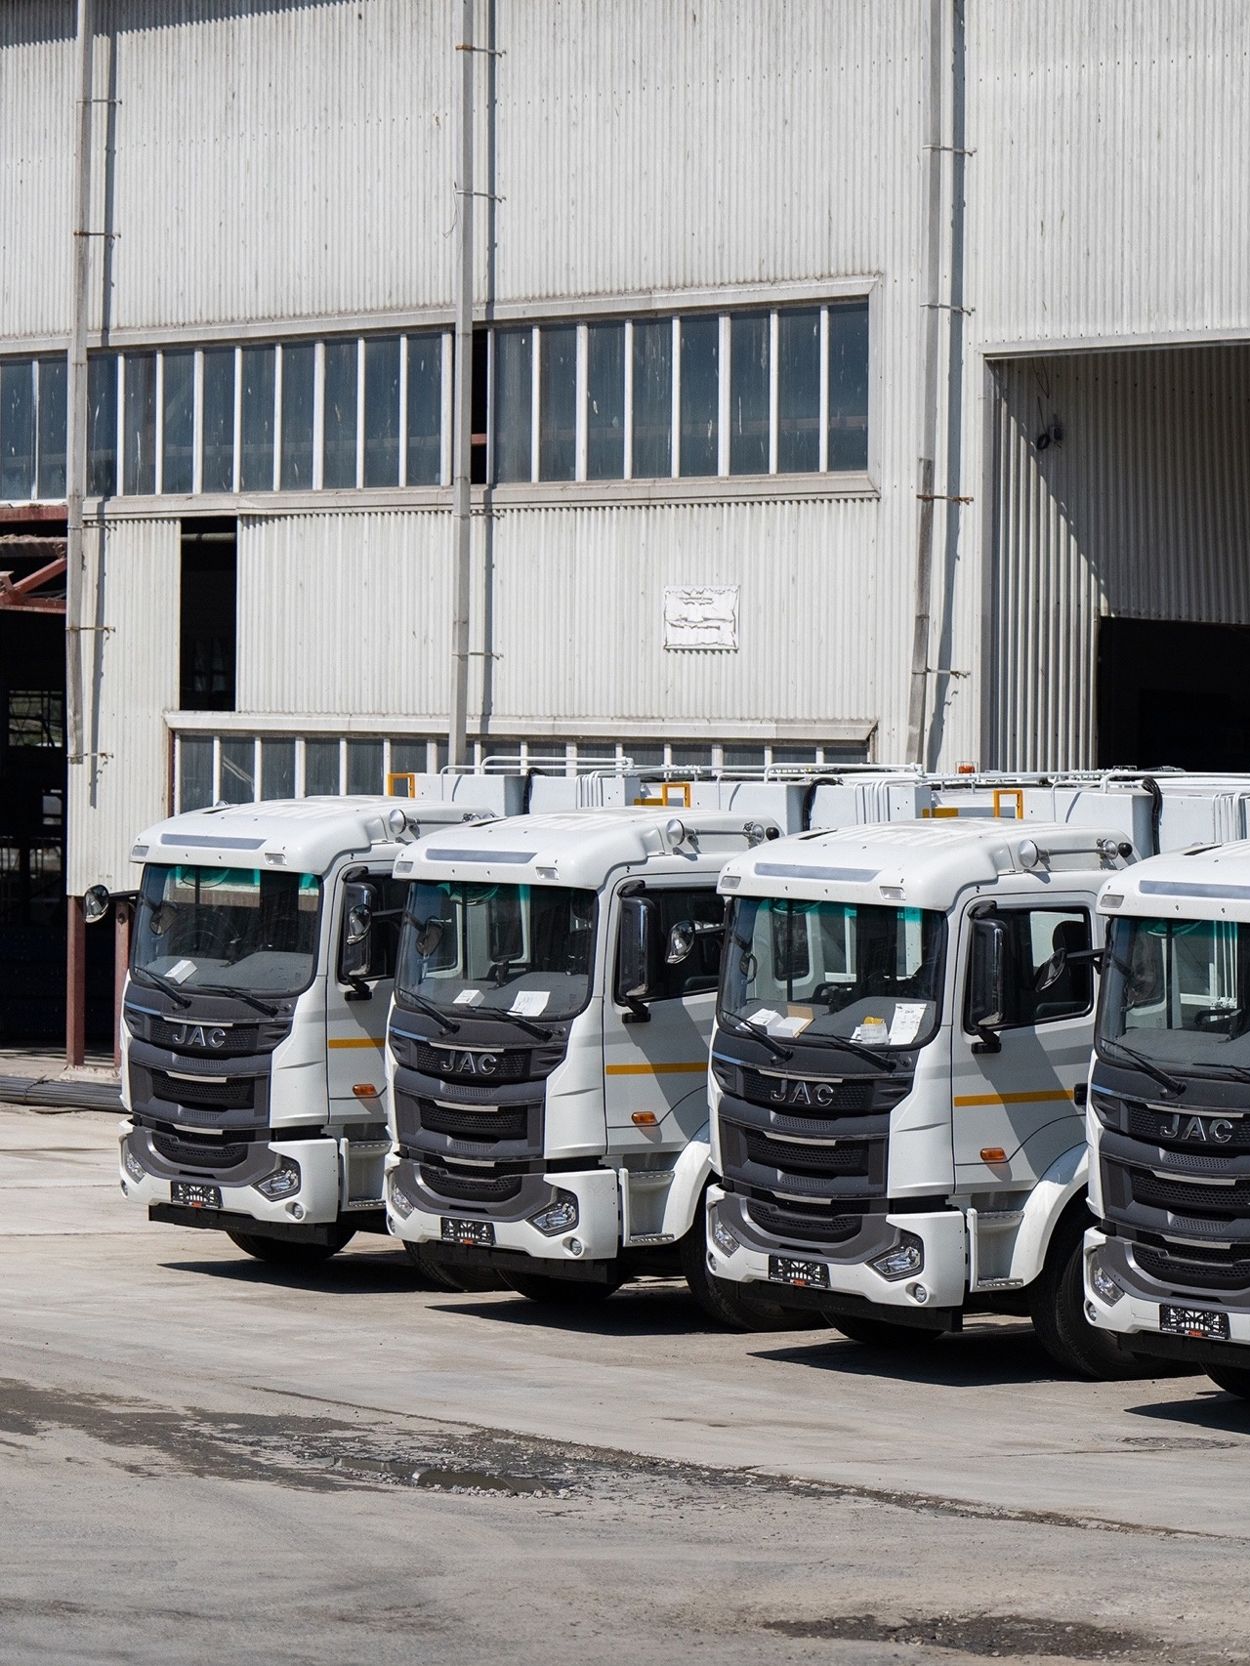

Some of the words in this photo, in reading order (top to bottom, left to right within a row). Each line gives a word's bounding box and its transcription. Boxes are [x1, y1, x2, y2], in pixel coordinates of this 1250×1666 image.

[172, 1024, 226, 1048] JAC
[440, 1050, 497, 1075] JAC
[770, 1079, 834, 1107] JAC
[1160, 1114, 1233, 1144] JAC
